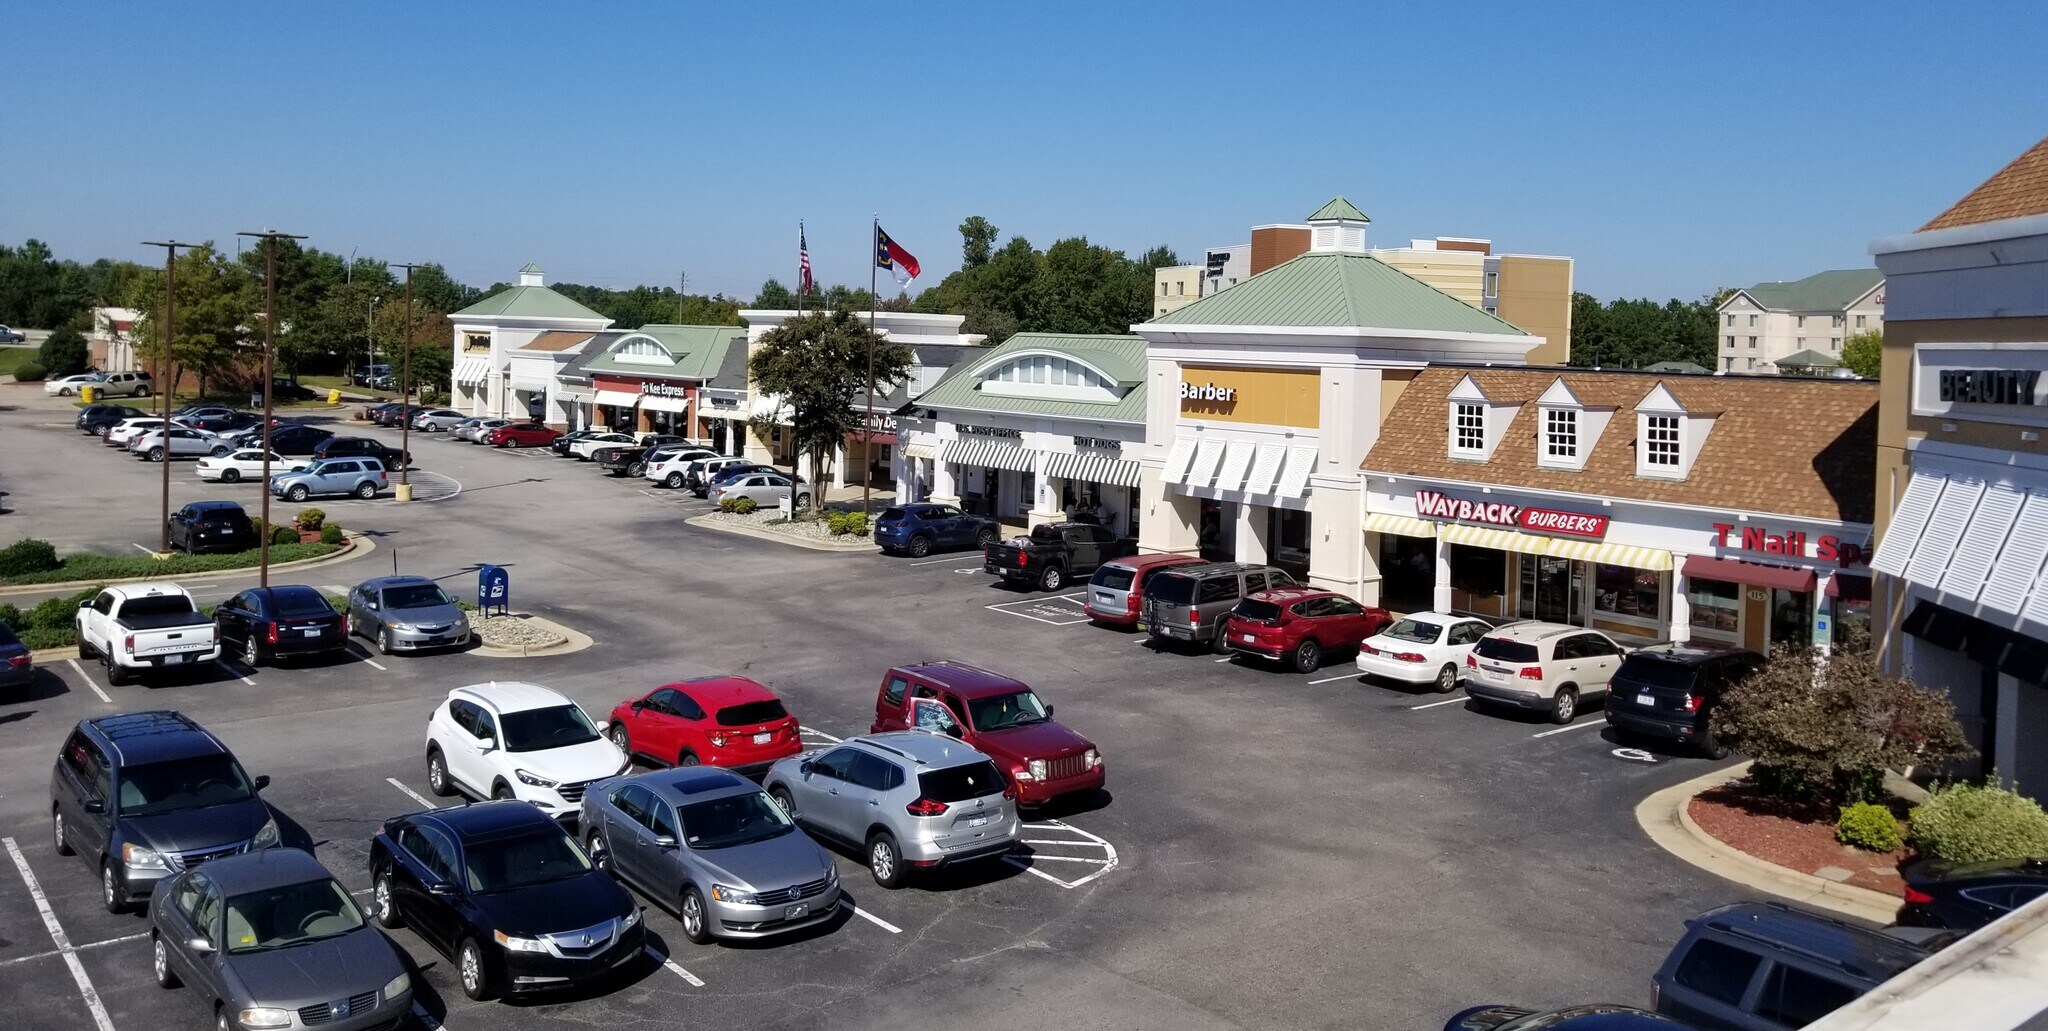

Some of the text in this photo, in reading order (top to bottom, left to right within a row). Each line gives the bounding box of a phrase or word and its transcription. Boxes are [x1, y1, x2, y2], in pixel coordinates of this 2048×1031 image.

[641, 382, 684, 397] Fu Kee Express
[1180, 381, 1234, 401] Barber
[1940, 370, 2033, 404] BEAUTY
[972, 426, 991, 435] POST
[992, 428, 1022, 439] OFFICE
[1074, 436, 1121, 450] HOT DOGS
[1415, 490, 1598, 532] WAYBACK BURGERS
[1713, 523, 1734, 547] T
[1742, 527, 1805, 557] Nail
[1751, 591, 1764, 600] 115
